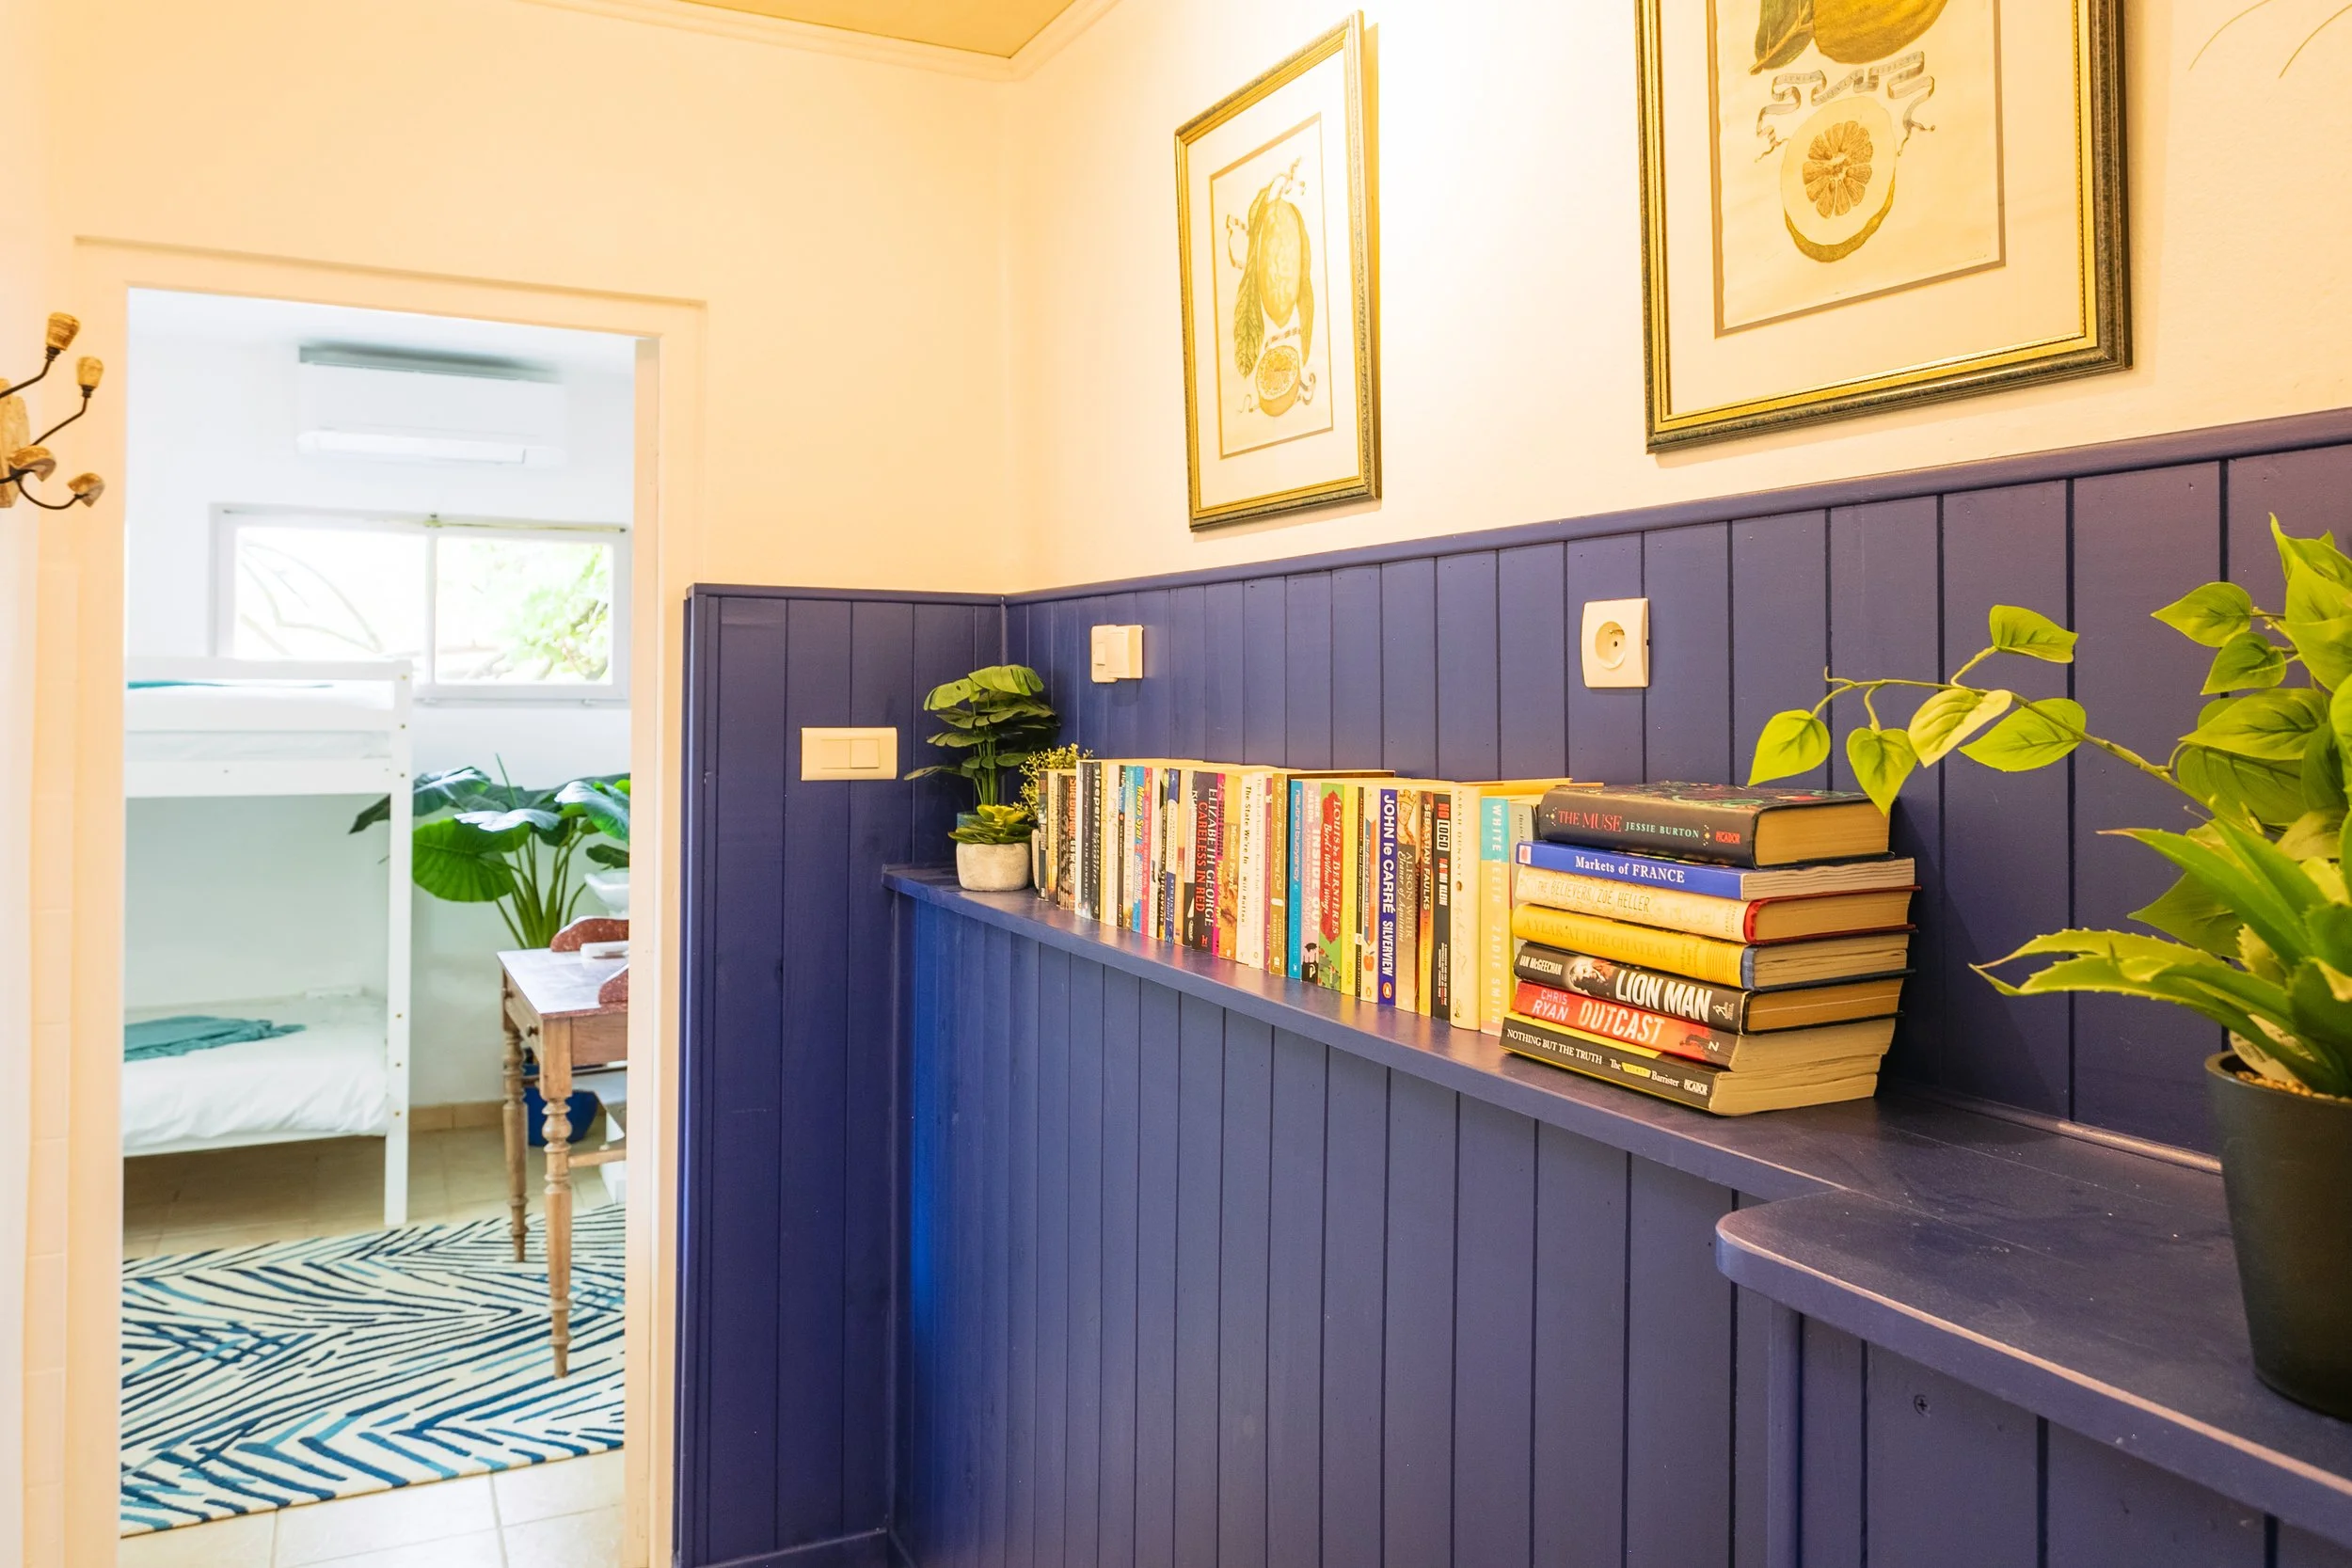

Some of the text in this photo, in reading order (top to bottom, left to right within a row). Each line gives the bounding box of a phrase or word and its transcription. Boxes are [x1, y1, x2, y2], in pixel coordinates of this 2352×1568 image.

[1135, 818, 1144, 839] Syal
[1324, 824, 1332, 850] Birds
[1333, 800, 1342, 843] LOUIS
[1438, 803, 1450, 849] NO LOGO
[1558, 811, 1699, 839] THE MUSE JESSIE BURTON
[1492, 804, 1502, 903] WHITE TEETH
[1716, 832, 1740, 844] PICADOR
[1195, 801, 1208, 911] CARELESS IN RED
[1205, 788, 1217, 927] ELIZABETH GEORGE
[1244, 856, 1249, 864] In
[1575, 856, 1685, 883] Markets of FRANCE
[1311, 829, 1321, 933] INSIDE OUT
[1382, 794, 1396, 976] JOHN le CARRÉ SILVERVIEW
[1398, 888, 1406, 898] of
[1438, 884, 1447, 907] KLEIN
[1550, 881, 1591, 900] BELIEVERS
[1617, 892, 1650, 912] HELLER
[1491, 924, 1502, 1023] ZADIE SMITH
[1519, 955, 1529, 967] IAN
[1530, 956, 1563, 976] McGEECHAN
[1615, 969, 1664, 1010] LION
[1663, 980, 1712, 1023] MAN
[1532, 999, 1569, 1023] RYAN
[1541, 990, 1568, 1005] CHRIS
[1578, 1001, 1665, 1045] OUTCAST
[1507, 1029, 1603, 1065] NOTHING BUT THE TRUTH
[1610, 1058, 1622, 1070] The
[1652, 1070, 1680, 1087] Barrister
